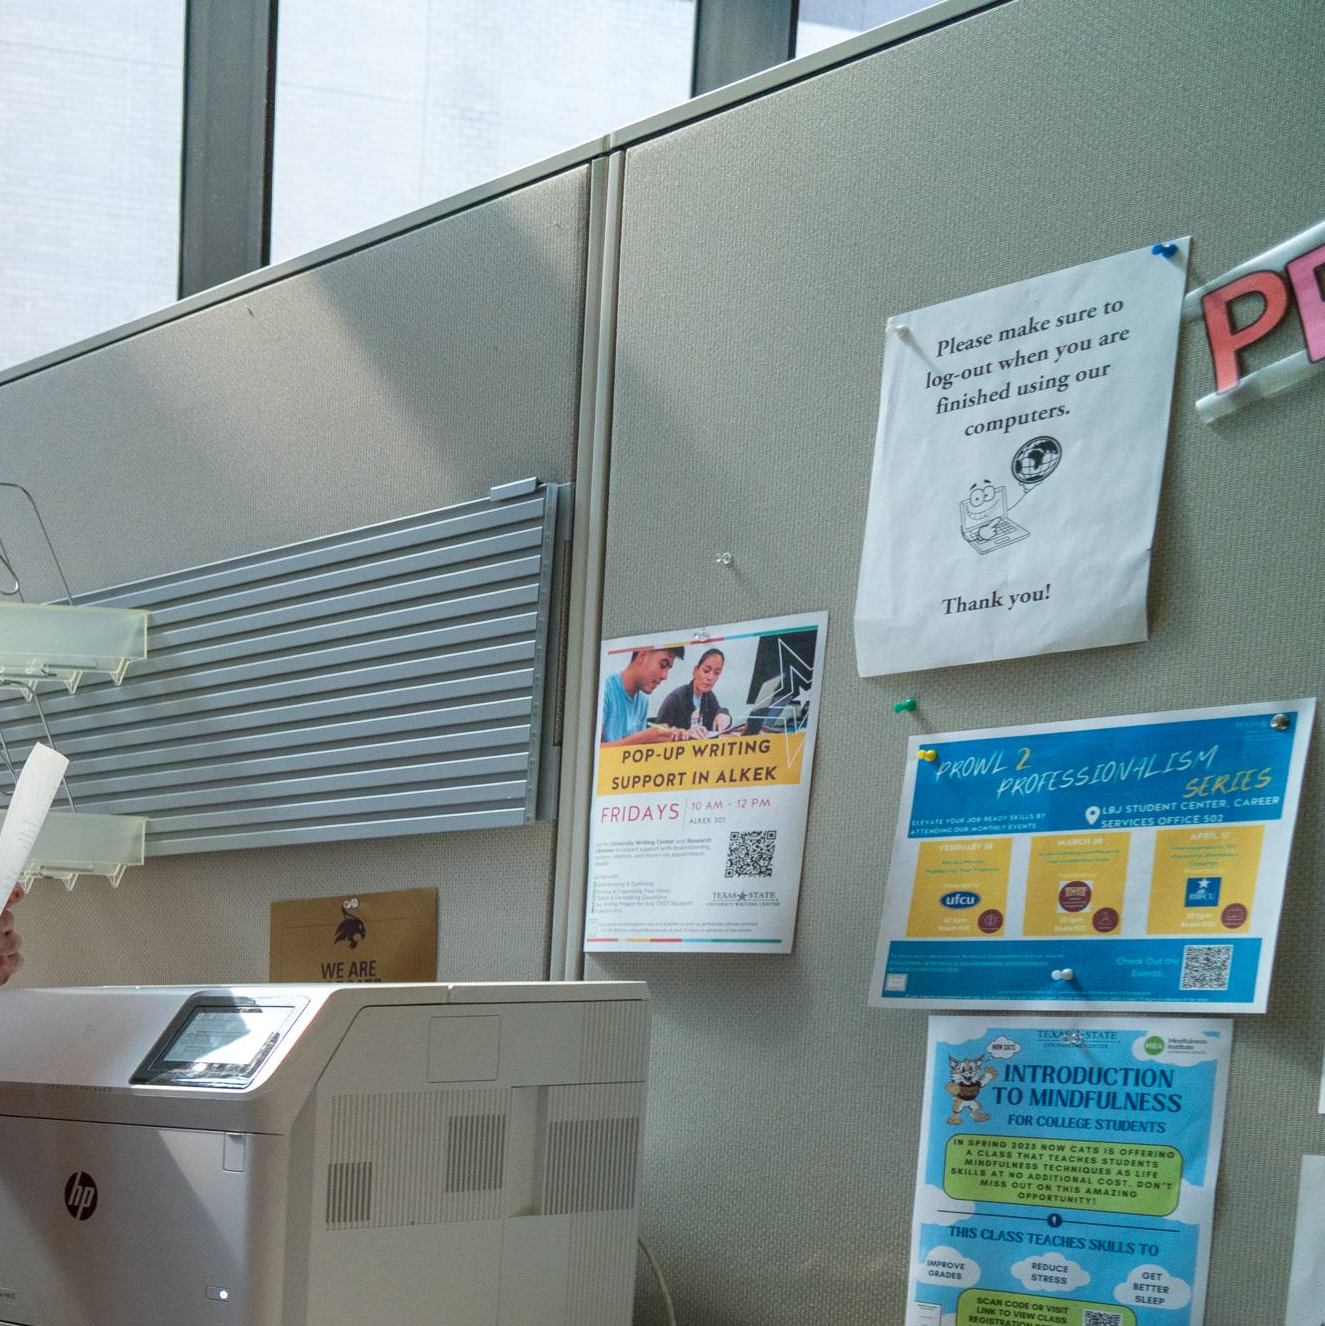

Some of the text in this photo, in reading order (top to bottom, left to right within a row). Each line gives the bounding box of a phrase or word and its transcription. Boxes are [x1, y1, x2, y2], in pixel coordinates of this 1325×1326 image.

[936, 299, 1124, 358] Please make sure to
[1202, 243, 1325, 395] P
[925, 328, 1131, 390] log-out when you are
[935, 363, 1111, 415] finished using our
[964, 404, 1071, 436] computers.
[942, 583, 1051, 615] Thank you!
[622, 739, 771, 764] POP-UP WRITING
[935, 747, 1032, 783] PROWL 2
[997, 745, 1219, 799] PROFESSIONALISM
[611, 765, 778, 790] SUPPORT IN ALKEK
[1182, 767, 1272, 798] SERIES
[601, 802, 680, 824] FRIDAYS
[705, 800, 724, 810] AM
[751, 797, 771, 808] PM
[1125, 802, 1177, 814] STUDENT
[1233, 796, 1280, 807] CAREER
[1100, 818, 1155, 829] SERVICES
[1158, 816, 1200, 826] OFFICE
[946, 893, 975, 905] ufcu
[320, 959, 377, 979] WE ARE
[1004, 1063, 1175, 1089] INTRODUCTION
[991, 1086, 1183, 1113] TO MINDFULNESS
[1007, 1113, 1167, 1134] FOR COLLEGE STUDENTS
[967, 1139, 1007, 1148] SPRING
[1040, 1143, 1066, 1152] NOW
[1069, 1145, 1100, 1154] CATS
[1103, 1147, 1115, 1155] IS
[1119, 1148, 1175, 1159] OFFERING
[976, 1149, 1013, 1158] CLASS
[1017, 1152, 1044, 1160] THAT
[1048, 1154, 1097, 1164] TEACHES
[1101, 1157, 1159, 1168] STUDENTS
[950, 1167, 986, 1176] SKILLS
[990, 1170, 1004, 1178] AT
[1008, 1171, 1023, 1179] NO
[1028, 1173, 1092, 1184] ADDITIONAL
[964, 1159, 1158, 1179] MINDFULNESS TECHNIQUES AS LIFE
[67, 1171, 96, 1220] hp
[979, 1179, 1007, 1188] MISS
[1011, 1181, 1033, 1190] OUT
[1056, 1185, 1081, 1194] THIS
[1085, 1188, 1138, 1199] AMAZING
[948, 1225, 1160, 1257] THIS CLASS TEACHES SKILLS TO
[926, 1259, 1070, 1275] IMPROVE REDUCE
[927, 1269, 1163, 1286] GRADES STRESS GET
[1132, 1282, 1170, 1295] BETTER
[976, 1297, 1070, 1314] SCAN CODE OR VISIT
[1134, 1295, 1166, 1306] SLEEP
[976, 1306, 1068, 1325] LINK TO VIEW CLASS
